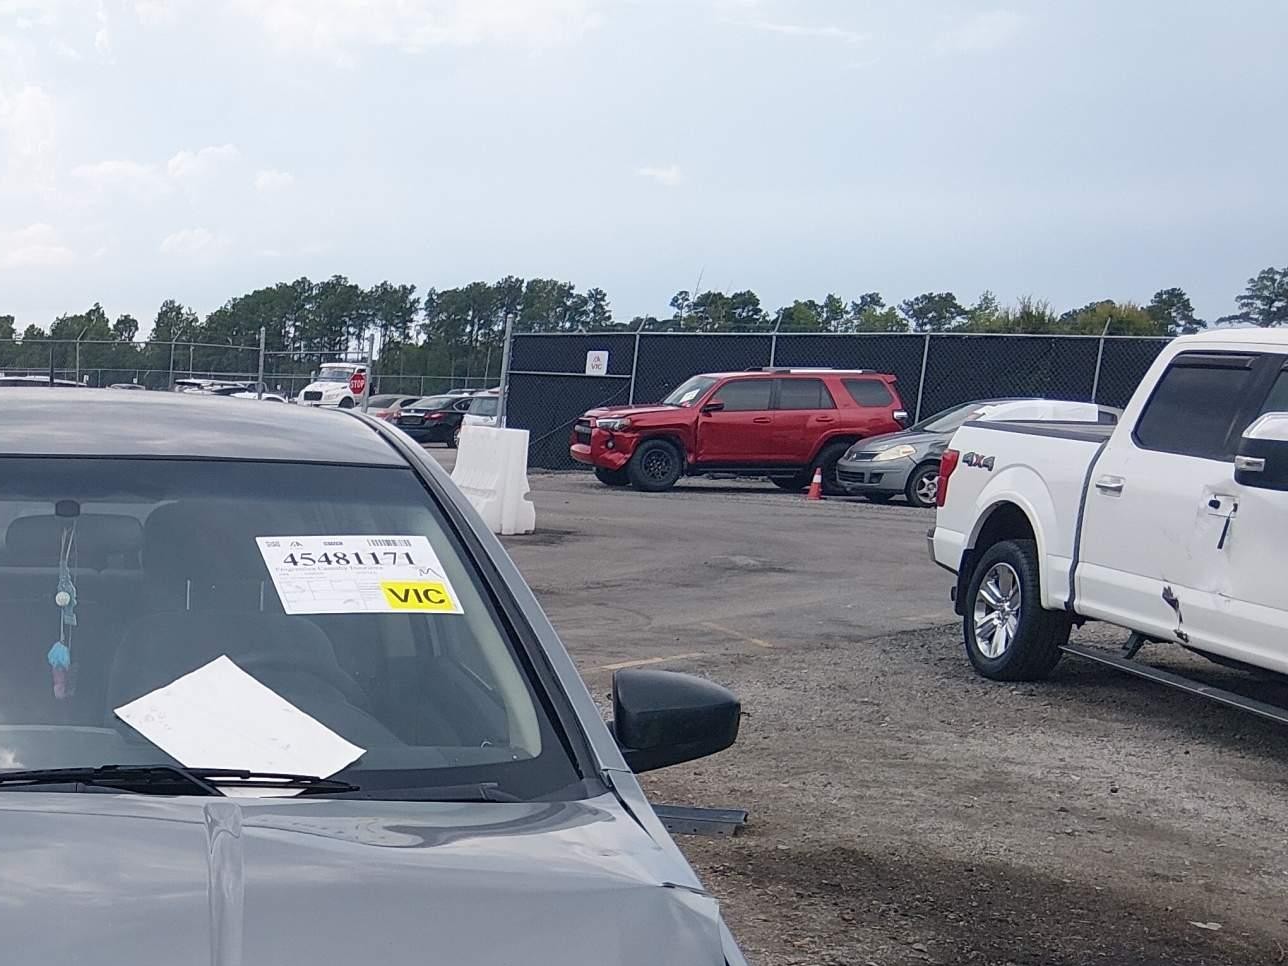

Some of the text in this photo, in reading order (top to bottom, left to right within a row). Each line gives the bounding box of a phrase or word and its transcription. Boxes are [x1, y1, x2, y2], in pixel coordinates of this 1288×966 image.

[350, 380, 365, 389] STOP
[283, 551, 416, 567] 45481171
[388, 588, 446, 605] VIC
